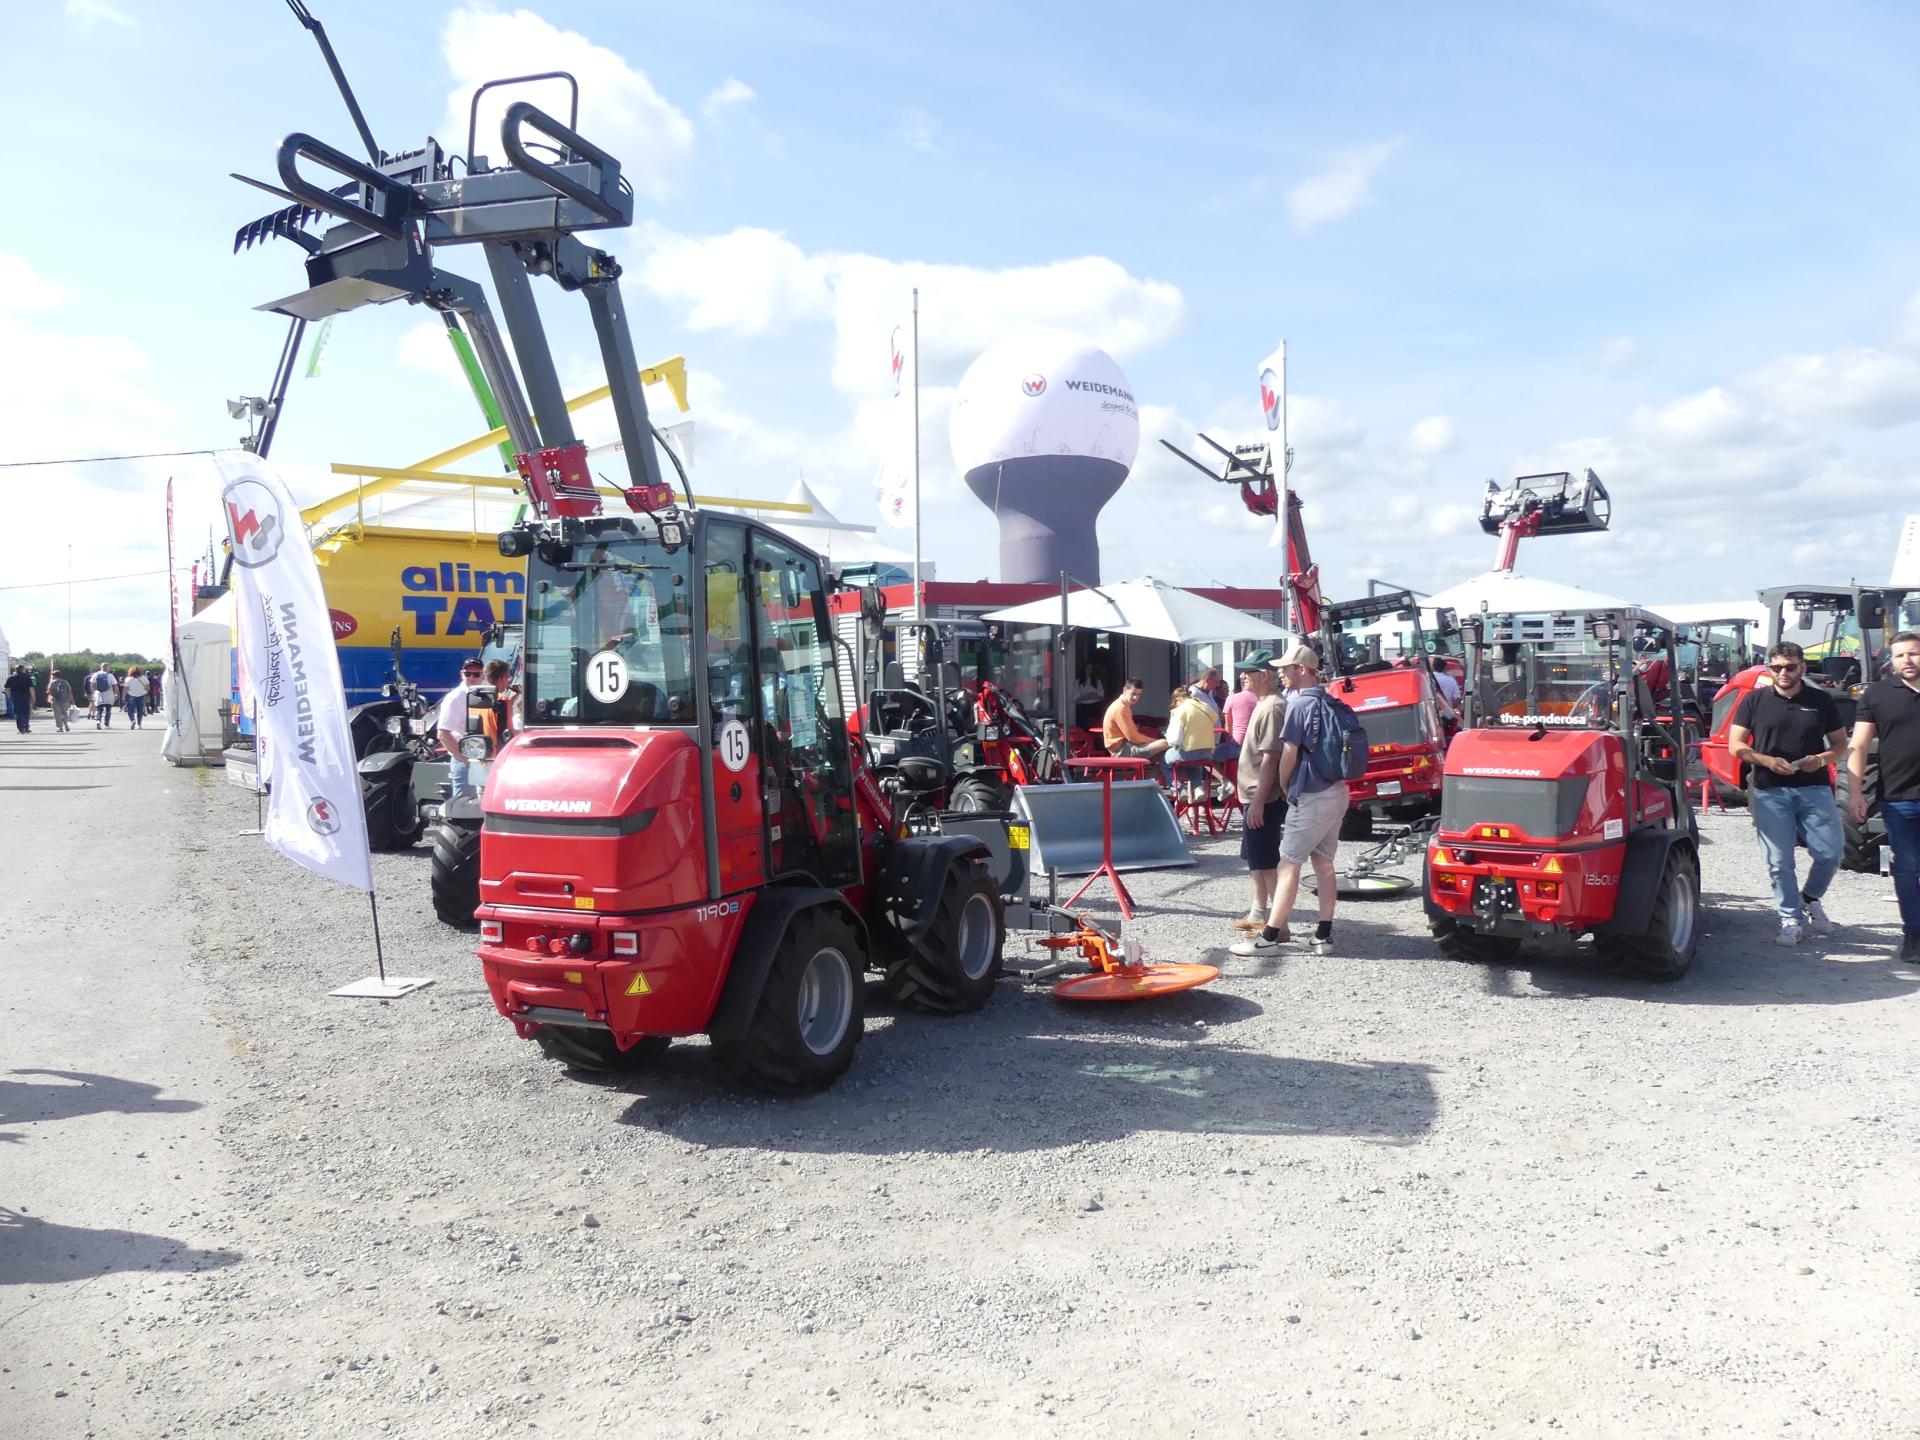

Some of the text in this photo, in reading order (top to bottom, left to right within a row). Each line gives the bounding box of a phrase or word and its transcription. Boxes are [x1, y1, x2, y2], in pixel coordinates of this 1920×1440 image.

[1065, 380, 1135, 404] WEIDEMANN
[596, 661, 620, 693] 15
[1500, 712, 1587, 726] the-ponderosa
[726, 729, 744, 762] 15
[1462, 767, 1540, 777] WEIDEMANN
[504, 798, 592, 814] WEIDEMANN
[696, 901, 740, 923] 1190e
